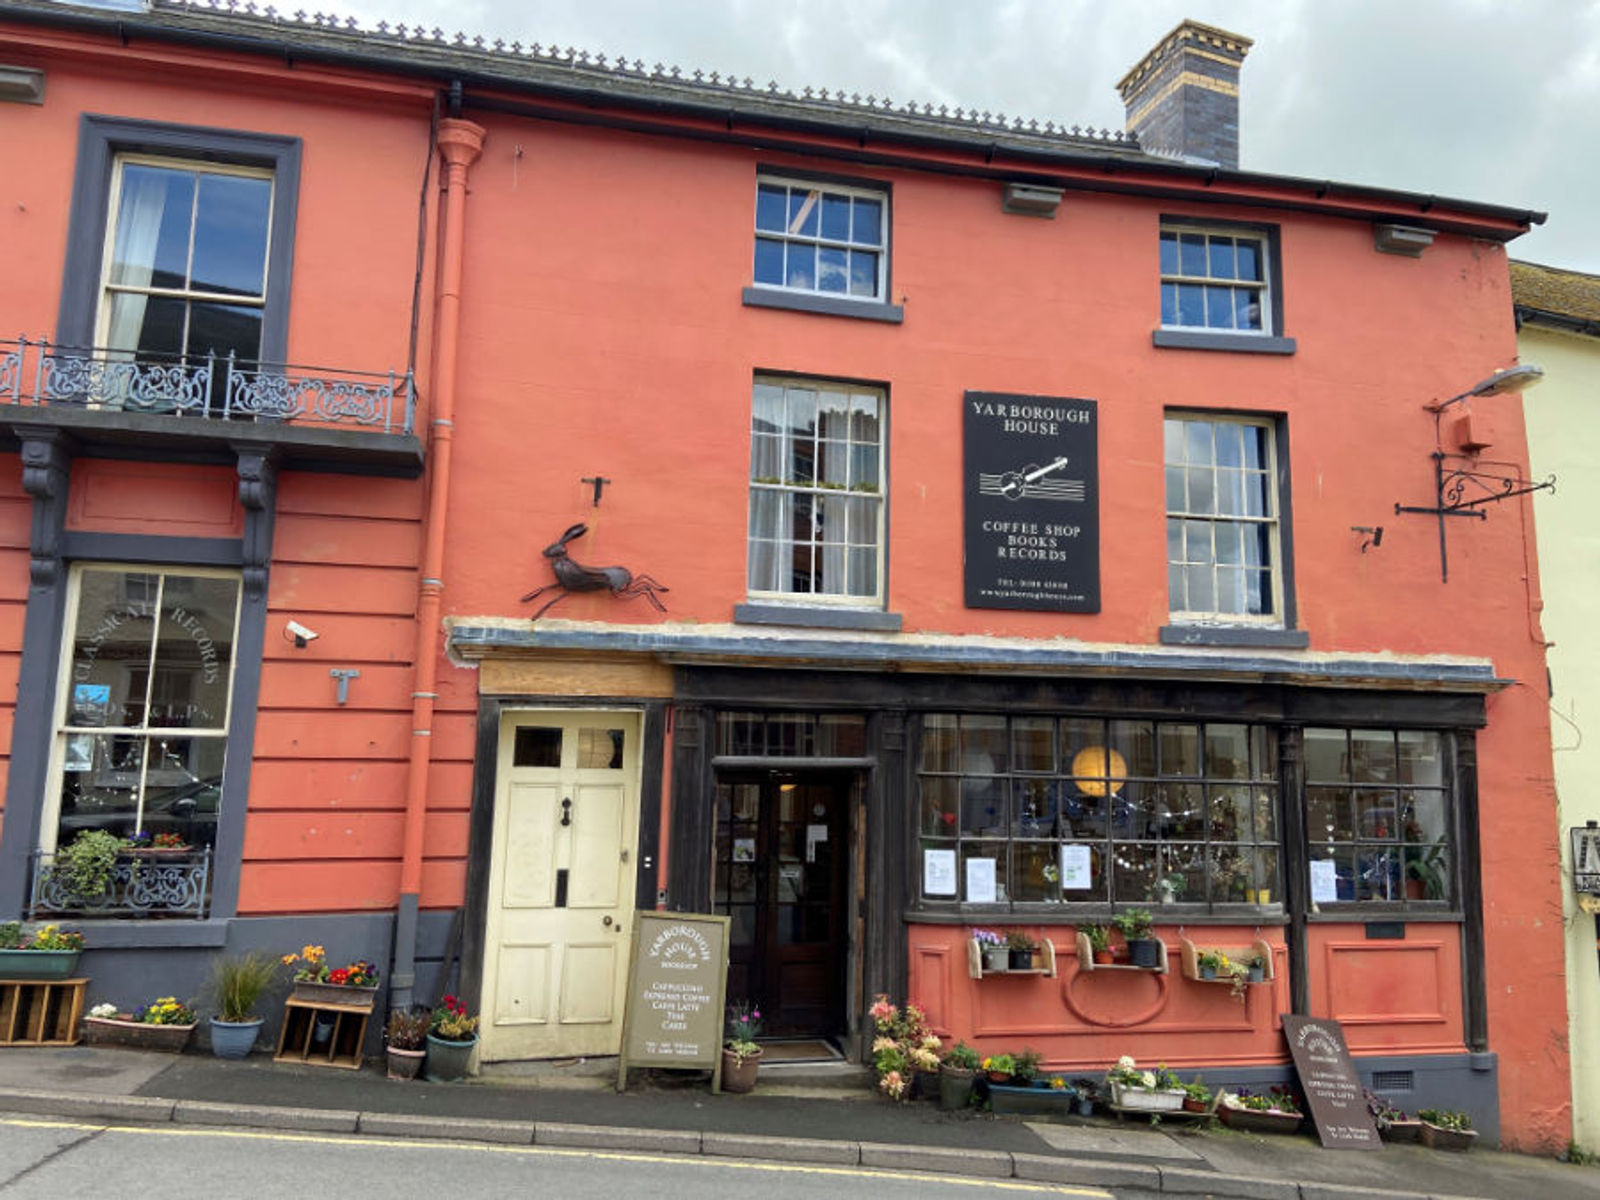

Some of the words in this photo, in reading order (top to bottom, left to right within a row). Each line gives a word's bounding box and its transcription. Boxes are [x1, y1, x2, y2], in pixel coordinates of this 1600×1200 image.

[973, 401, 1090, 425] YARBOROUGH
[1004, 420, 1059, 436] HOUSE
[982, 520, 1038, 535] COFFEE
[1045, 524, 1081, 538] SHOP
[1007, 535, 1058, 548] BOOKS
[998, 547, 1067, 562] RECORDS
[170, 607, 219, 685] RECORDS
[648, 924, 711, 962] YARBOROUGH
[664, 942, 697, 960] HOUSE
[677, 1001, 700, 1012] LATTE
